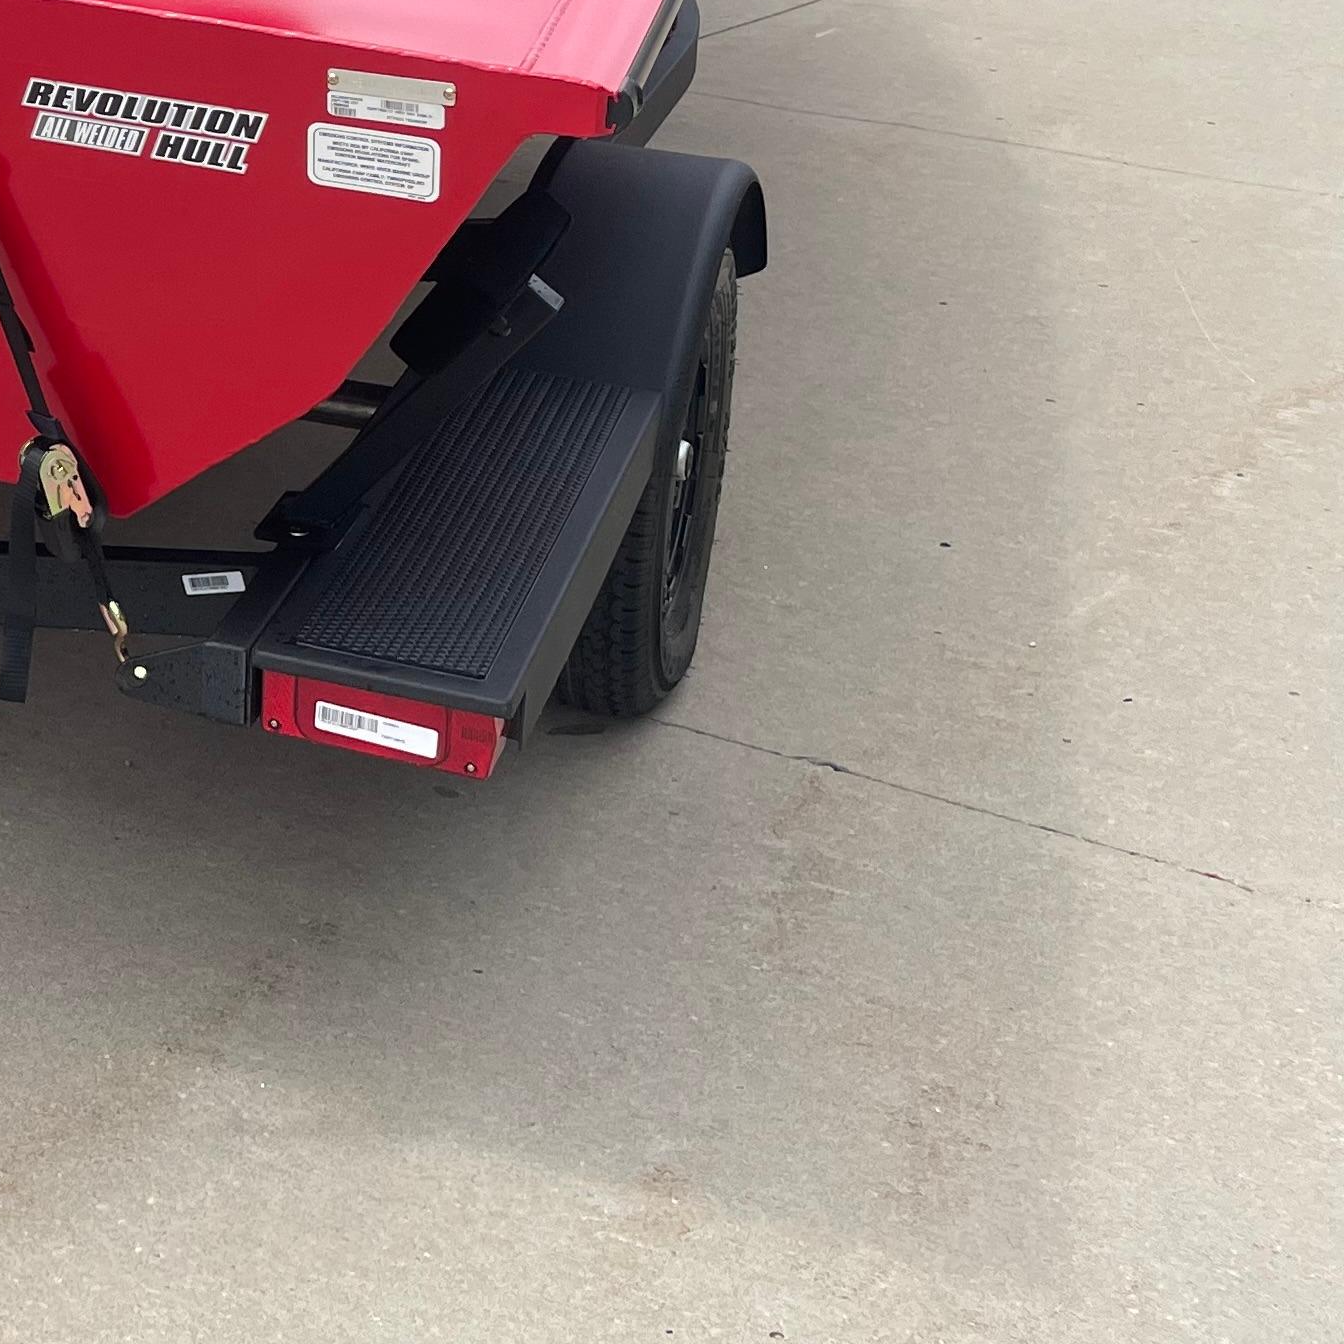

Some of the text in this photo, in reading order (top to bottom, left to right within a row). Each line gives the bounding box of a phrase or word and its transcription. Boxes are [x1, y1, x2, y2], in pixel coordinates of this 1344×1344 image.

[26, 81, 263, 140] REVOLUTION
[41, 117, 249, 171] ALL WELDED HULL
